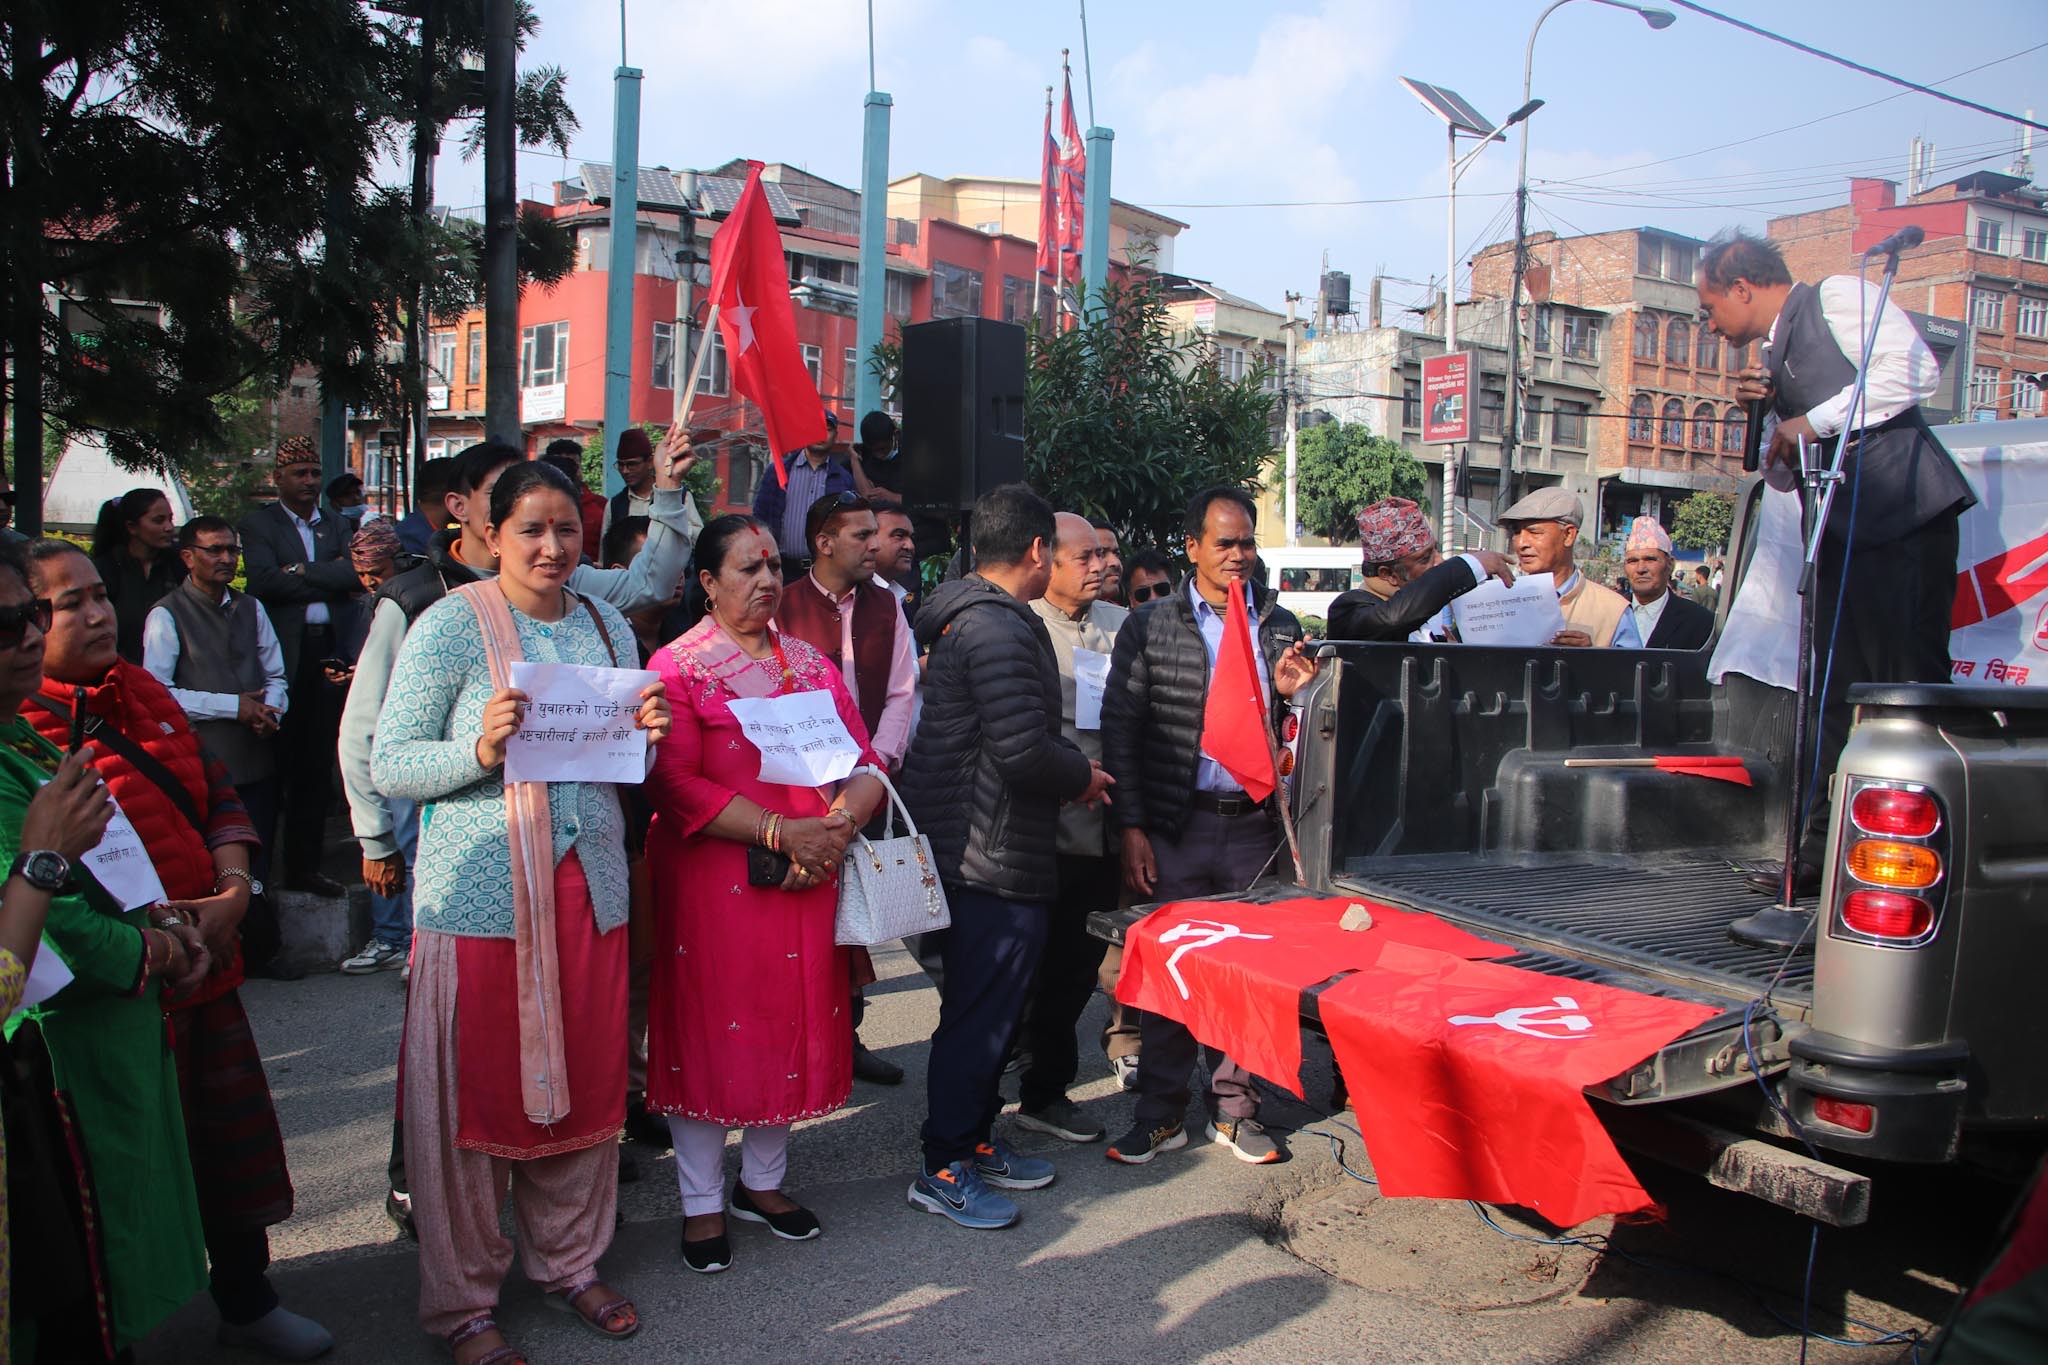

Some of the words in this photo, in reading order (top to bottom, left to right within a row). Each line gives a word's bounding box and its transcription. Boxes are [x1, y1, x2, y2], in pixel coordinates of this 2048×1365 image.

[1984, 658, 2030, 686] चिन्ह
[594, 701, 619, 718] एउटै
[582, 728, 608, 742] कालो
[612, 727, 632, 741] खोर
